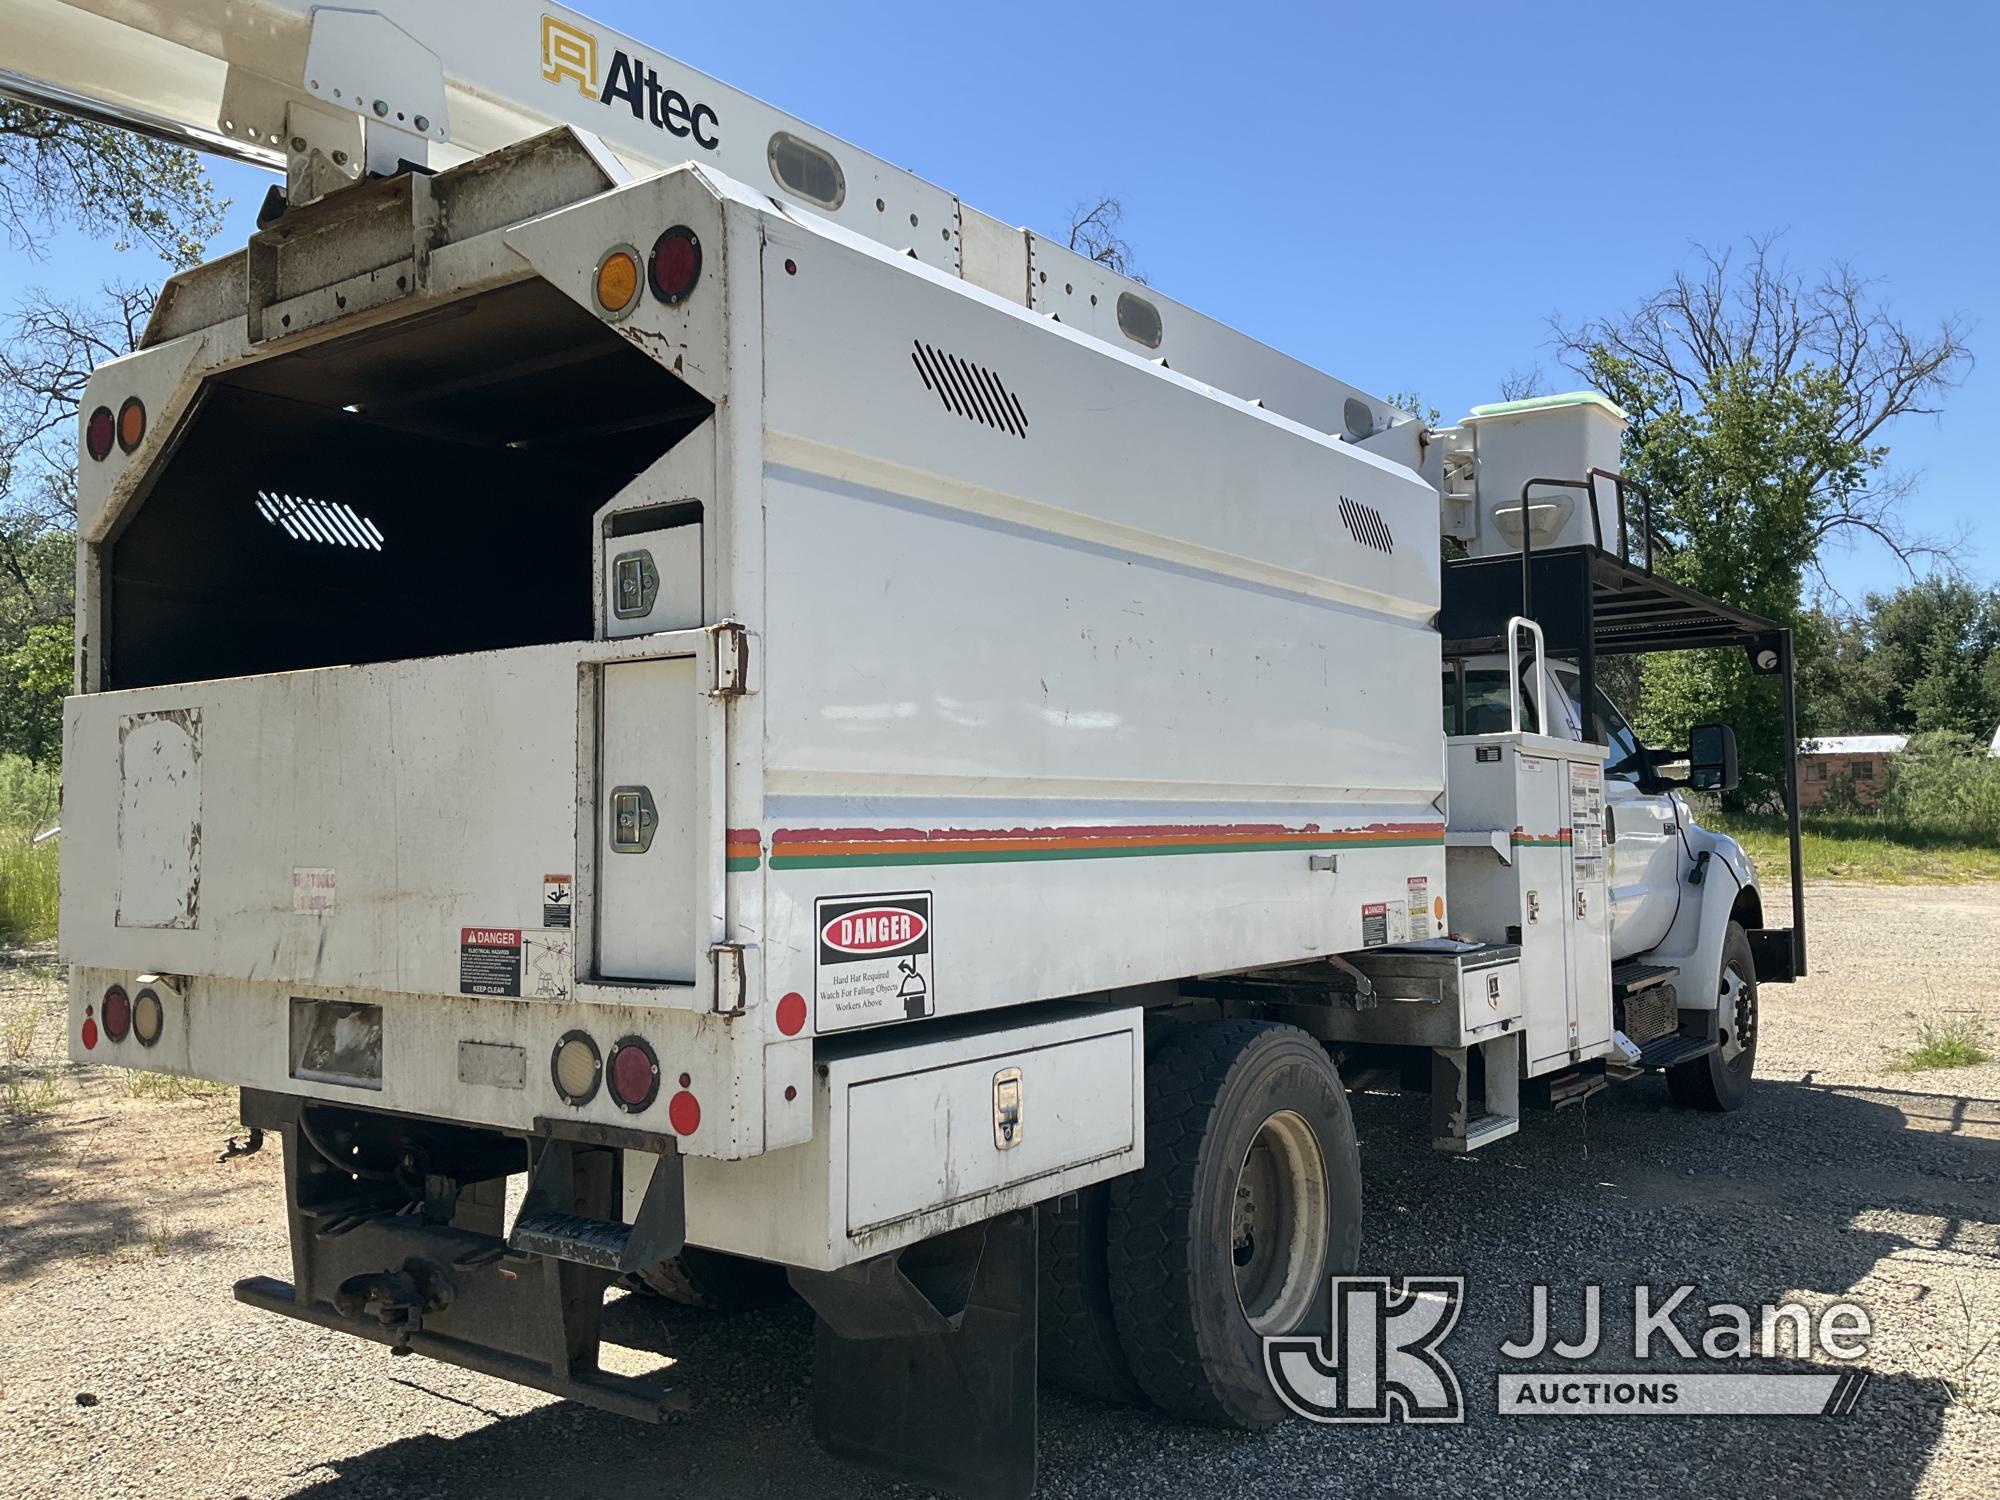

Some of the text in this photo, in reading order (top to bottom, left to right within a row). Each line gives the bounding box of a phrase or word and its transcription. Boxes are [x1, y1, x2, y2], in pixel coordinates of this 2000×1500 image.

[600, 50, 719, 150] Altec
[841, 915, 911, 945] DANGER
[477, 932, 514, 944] DANGER
[833, 971, 890, 986] Hard Hat Required
[473, 985, 504, 994] KEEP CLEAR
[820, 984, 898, 1000] Watch For Falling Objects
[836, 998, 882, 1012] Workers Above
